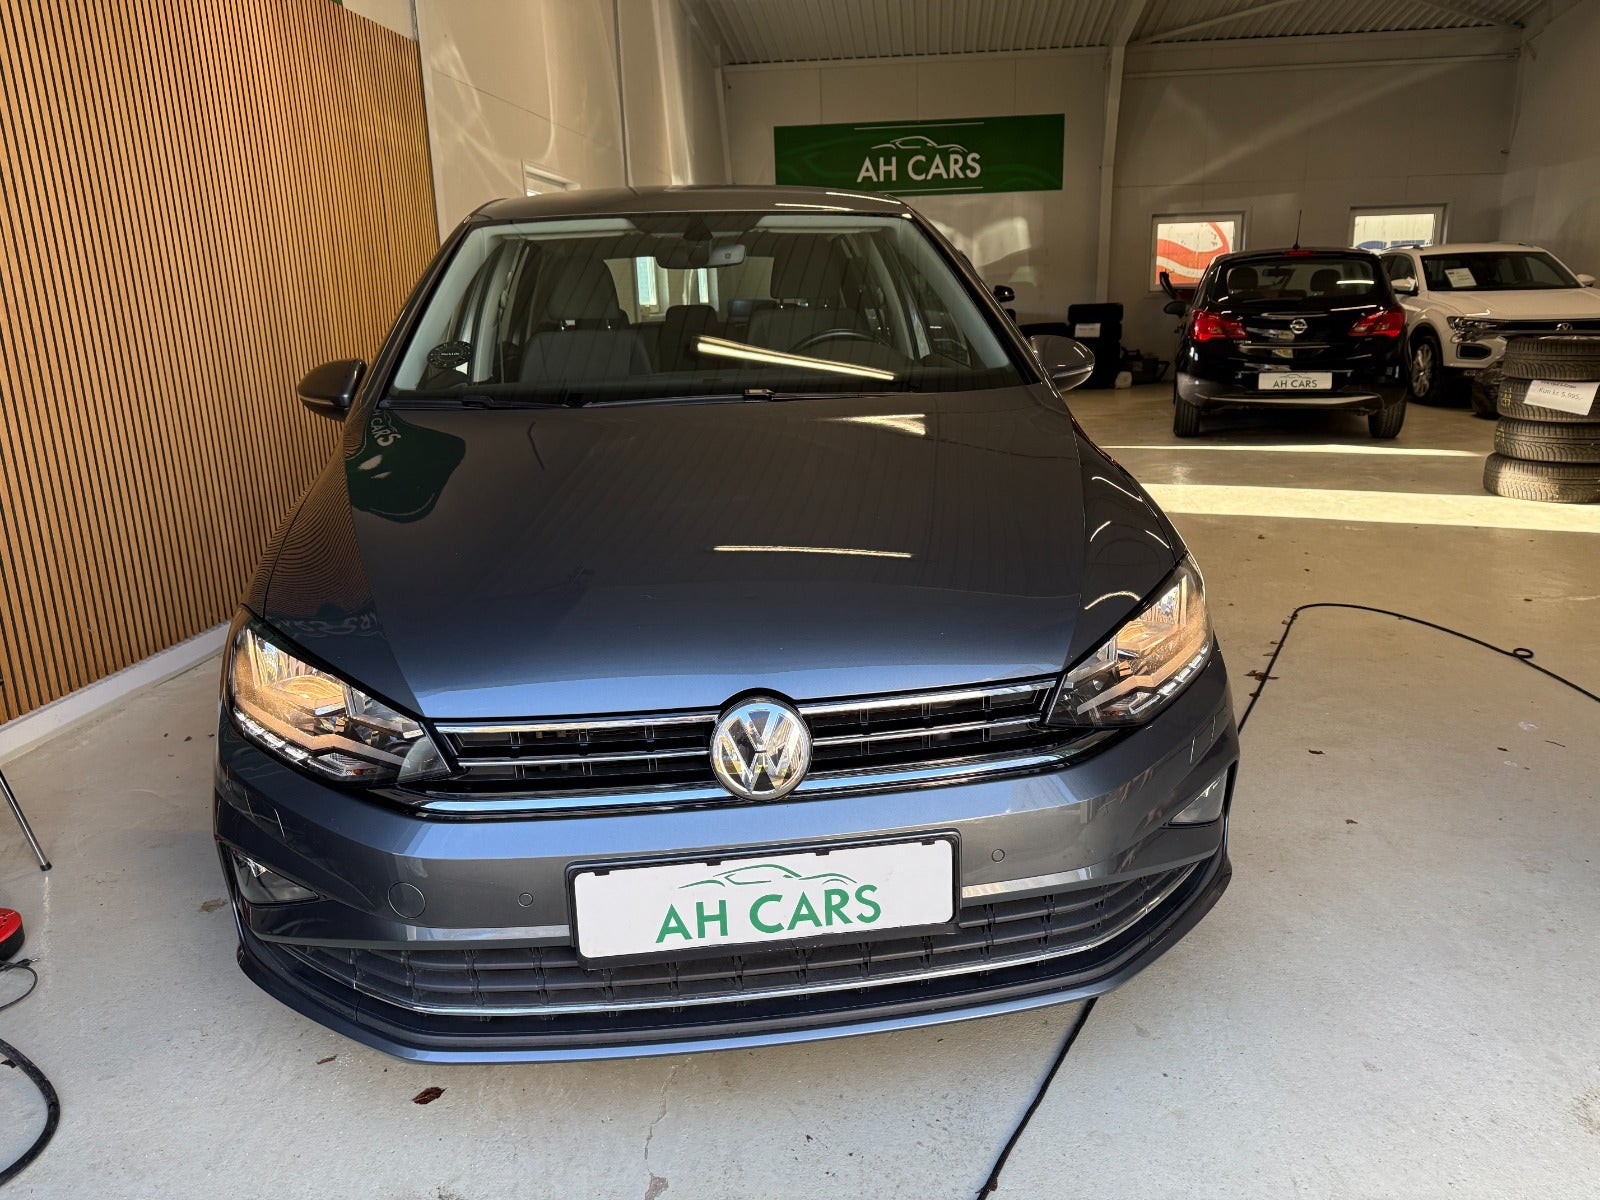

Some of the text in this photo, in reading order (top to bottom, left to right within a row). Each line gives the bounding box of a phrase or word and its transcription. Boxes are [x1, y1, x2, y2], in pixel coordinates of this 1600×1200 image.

[857, 152, 981, 183] AH CARS
[1273, 379, 1318, 389] AH CARS
[655, 884, 882, 944] AH CARS
